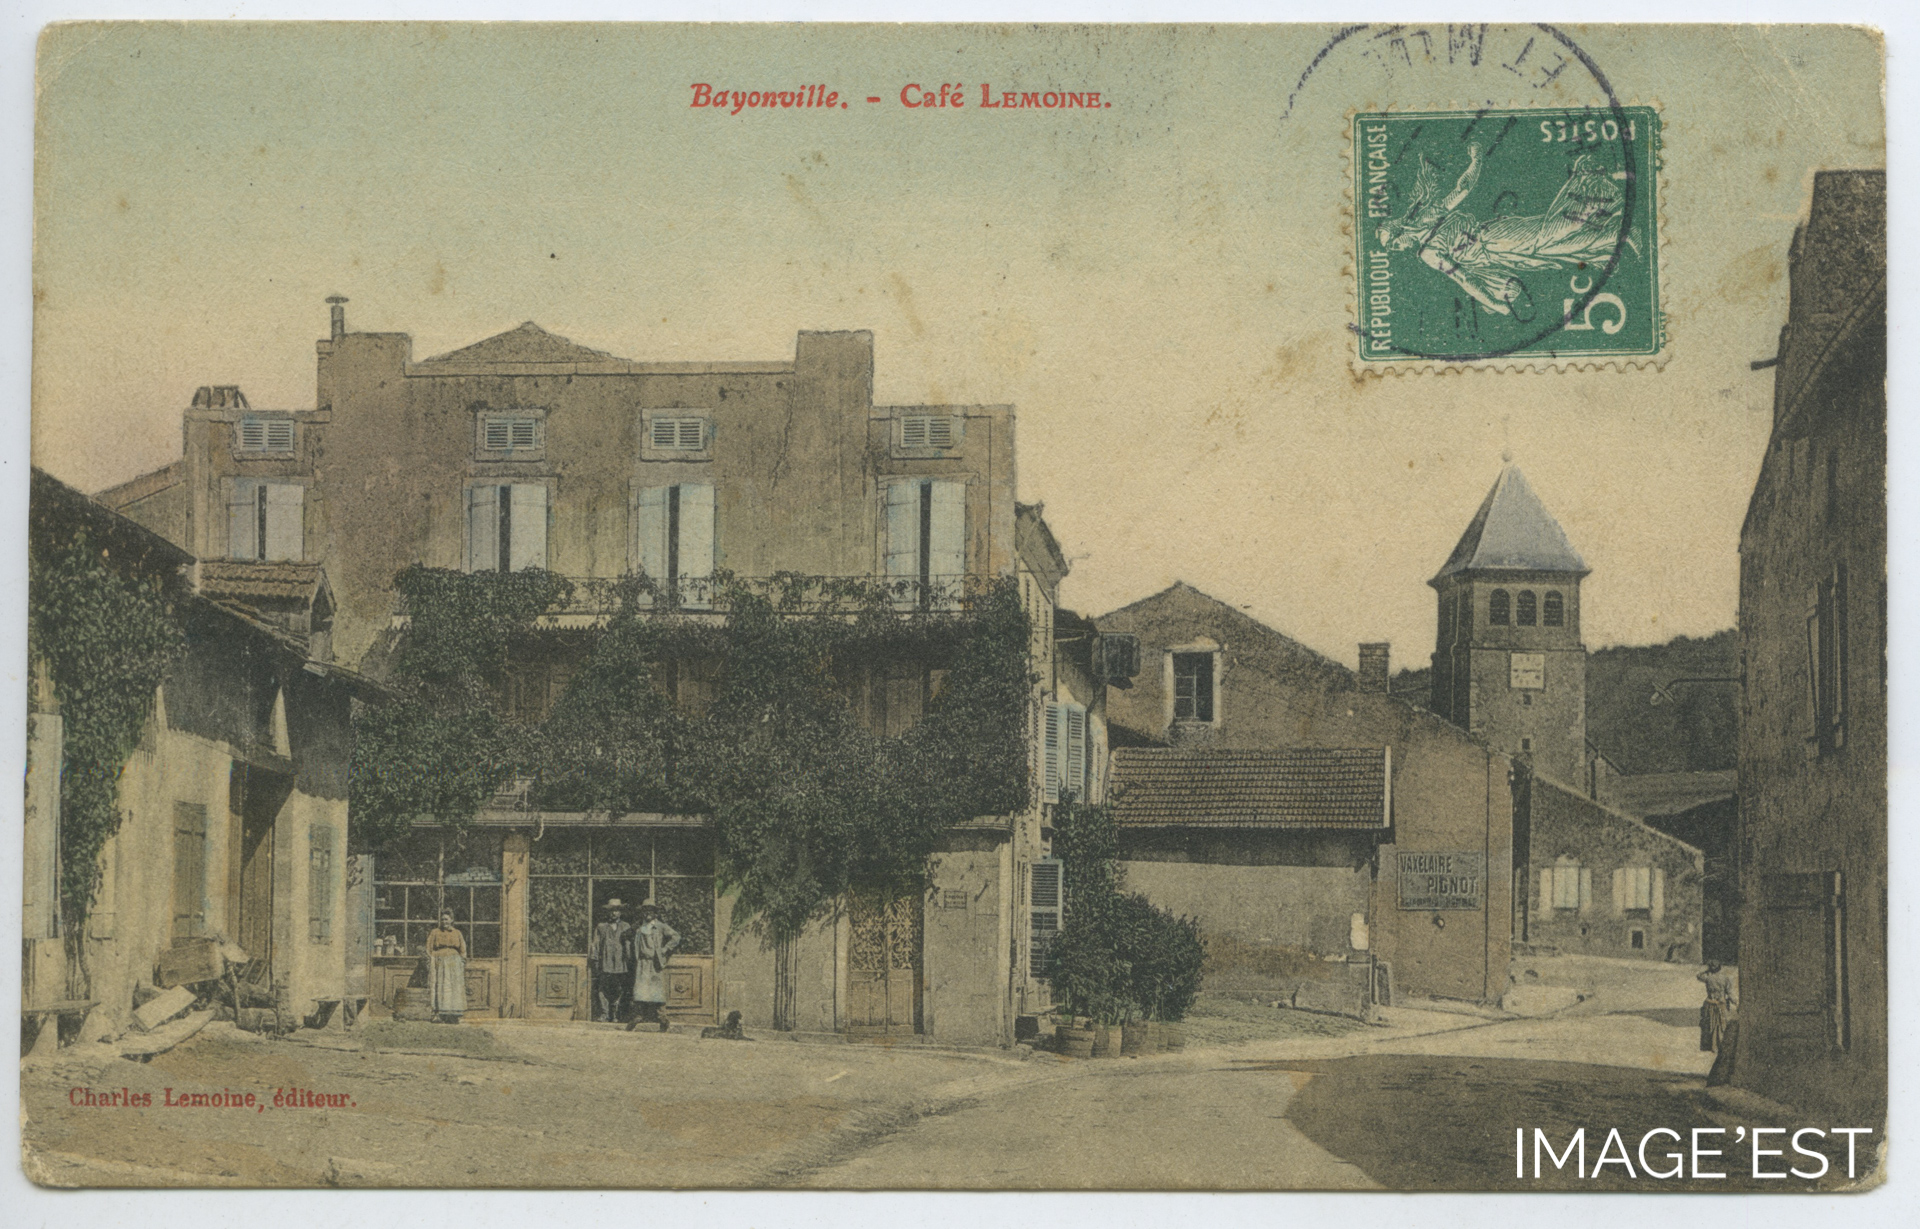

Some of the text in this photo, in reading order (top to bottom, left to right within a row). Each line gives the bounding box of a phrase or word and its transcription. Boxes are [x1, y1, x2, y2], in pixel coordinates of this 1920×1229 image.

[689, 82, 849, 116] Bayonville.
[900, 82, 965, 109] Café
[979, 82, 1113, 109] LEMOINE.
[1401, 855, 1453, 874] VAXELAIRE
[1427, 876, 1478, 895] PIGNOT
[68, 1087, 358, 1114] Charles Lemoine, éditeur.
